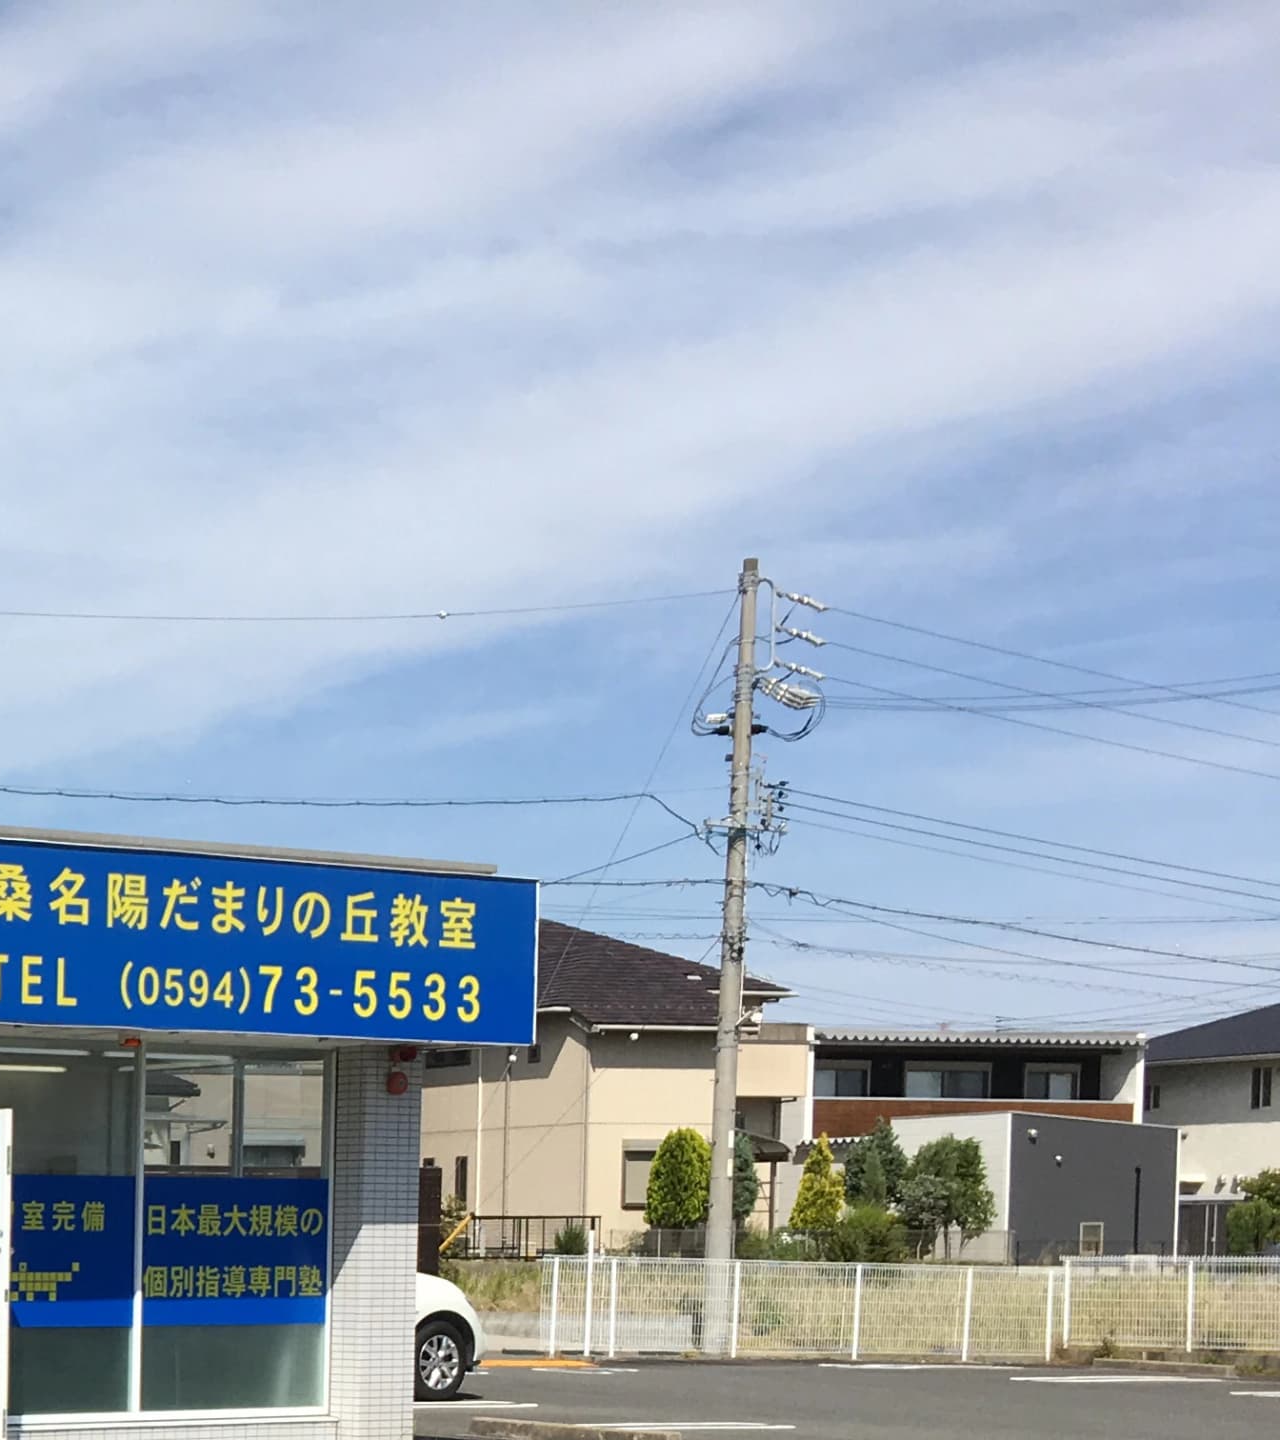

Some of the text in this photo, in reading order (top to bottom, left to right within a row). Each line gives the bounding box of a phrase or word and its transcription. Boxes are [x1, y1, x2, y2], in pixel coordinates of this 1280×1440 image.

[120, 960, 482, 1024] (0594)73-5533
[146, 1203, 324, 1238] 日本最大規模の
[143, 1263, 326, 1301] 個別指導専門塾
